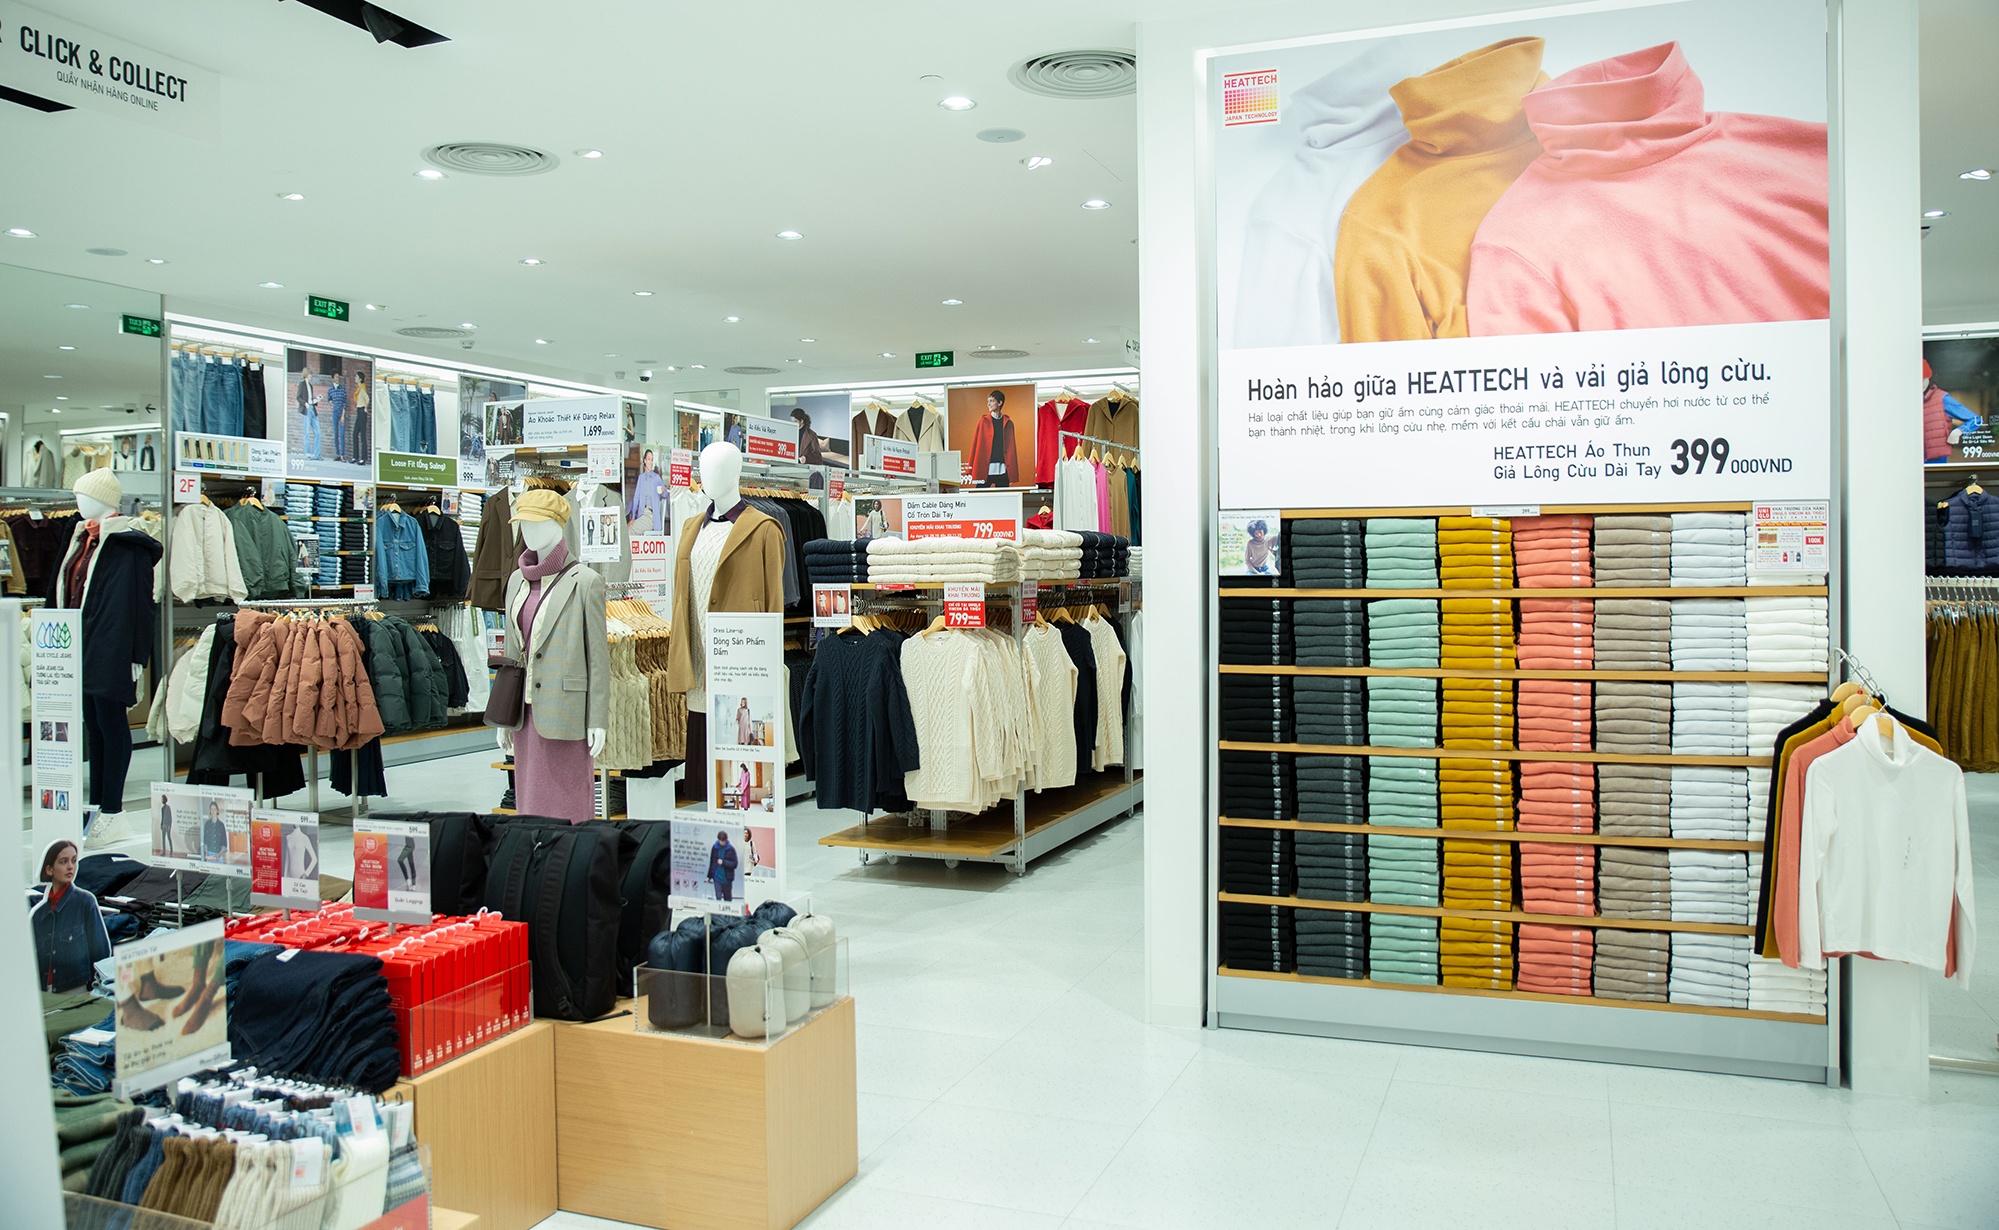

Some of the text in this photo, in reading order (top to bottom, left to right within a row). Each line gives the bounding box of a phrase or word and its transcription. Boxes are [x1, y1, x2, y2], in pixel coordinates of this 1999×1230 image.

[20, 25, 82, 69] CLICK
[88, 49, 103, 76] &
[109, 56, 187, 102] COLLECT
[1224, 74, 1277, 88] HEATTECH
[81, 78, 104, 95] NHẬN
[106, 87, 128, 102] HÀNG
[130, 94, 158, 111] ONLINE
[1244, 111, 1277, 119] TECHNOLOGY
[1248, 357, 1771, 402] Hoàn hảo giữa HEATTECH và vải giả lông cừu.
[1248, 412, 1263, 422] Hai
[1267, 411, 1283, 424] loại
[1287, 409, 1307, 421] chất
[1312, 410, 1328, 422] liệu
[1332, 409, 1352, 423] giúp
[1356, 409, 1374, 421] bạn
[1419, 405, 1443, 419] cùng
[1475, 404, 1495, 417] giác
[1554, 400, 1615, 411] HEATTECH
[1620, 396, 1658, 412] chuyển
[1663, 396, 1679, 408] hơi
[1684, 395, 1710, 407] nước
[1752, 391, 1769, 405] thể
[599, 411, 616, 420] Relax
[583, 425, 602, 437] 1.699
[1270, 425, 1296, 436] thành
[1330, 424, 1356, 436] trong
[1360, 423, 1374, 434] khi
[1378, 422, 1399, 435] lông
[1501, 416, 1517, 428] kết
[1494, 441, 1650, 460] HEATTECH Áo Thun
[1962, 446, 1983, 458] 999
[291, 459, 305, 471] 999
[390, 458, 407, 468] Loose
[407, 459, 416, 468] Fit
[1494, 462, 1662, 481] Giả Lông Cừu Dài Tay
[179, 478, 196, 493] 2F
[922, 501, 937, 509] Cable
[942, 511, 953, 519] Tay
[972, 522, 994, 539] 799
[640, 541, 666, 554] .com
[949, 612, 968, 625] 799
